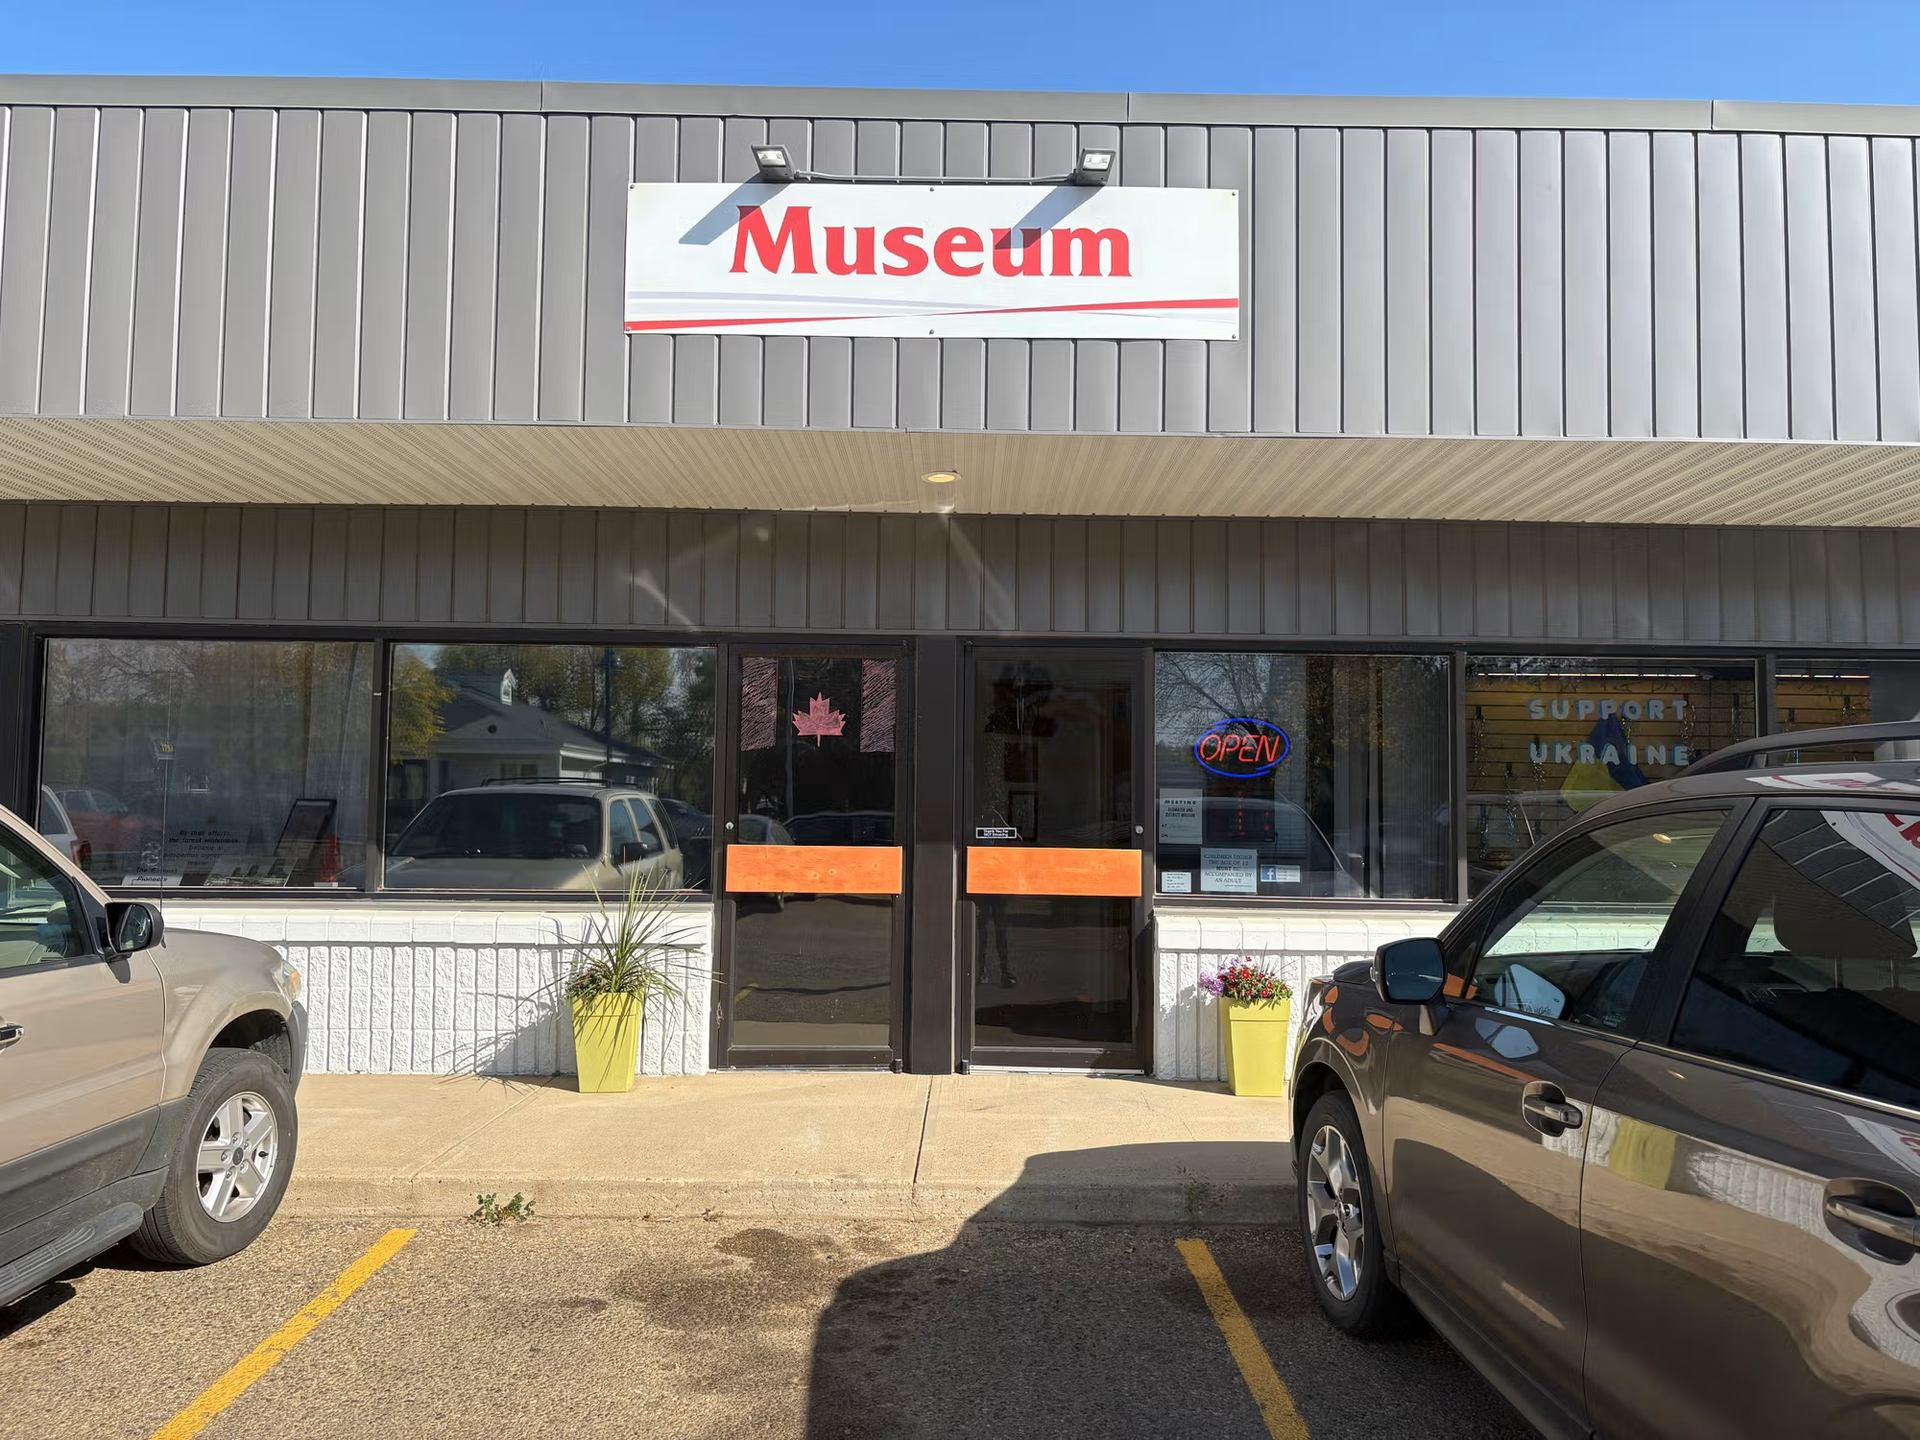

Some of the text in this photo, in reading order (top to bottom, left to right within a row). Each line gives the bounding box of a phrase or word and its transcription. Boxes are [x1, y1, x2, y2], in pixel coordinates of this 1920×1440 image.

[729, 205, 1132, 277] Museum
[1528, 699, 1688, 720] SUPPORT
[1200, 734, 1280, 762] OPEN
[1528, 742, 1690, 766] UKRAINE
